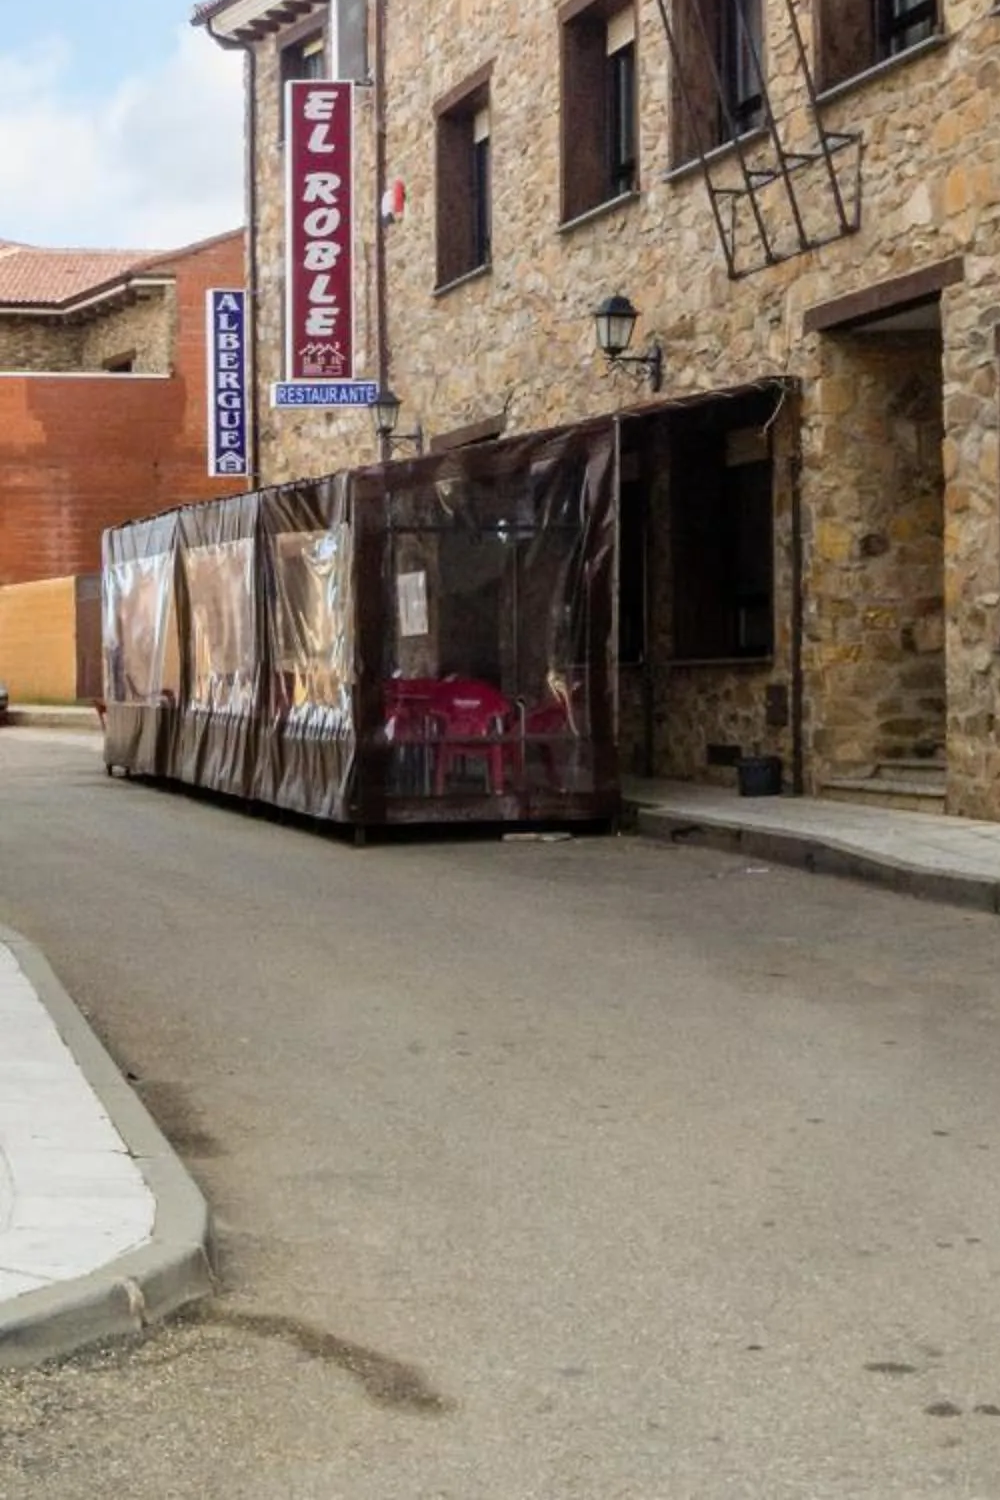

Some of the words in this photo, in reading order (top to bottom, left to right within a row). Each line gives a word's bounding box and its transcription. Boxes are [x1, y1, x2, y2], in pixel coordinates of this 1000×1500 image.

[303, 90, 339, 153] EL
[303, 171, 342, 336] ROBLE
[217, 294, 242, 449] ALBERGUE
[278, 385, 376, 403] RESTAURANTE
